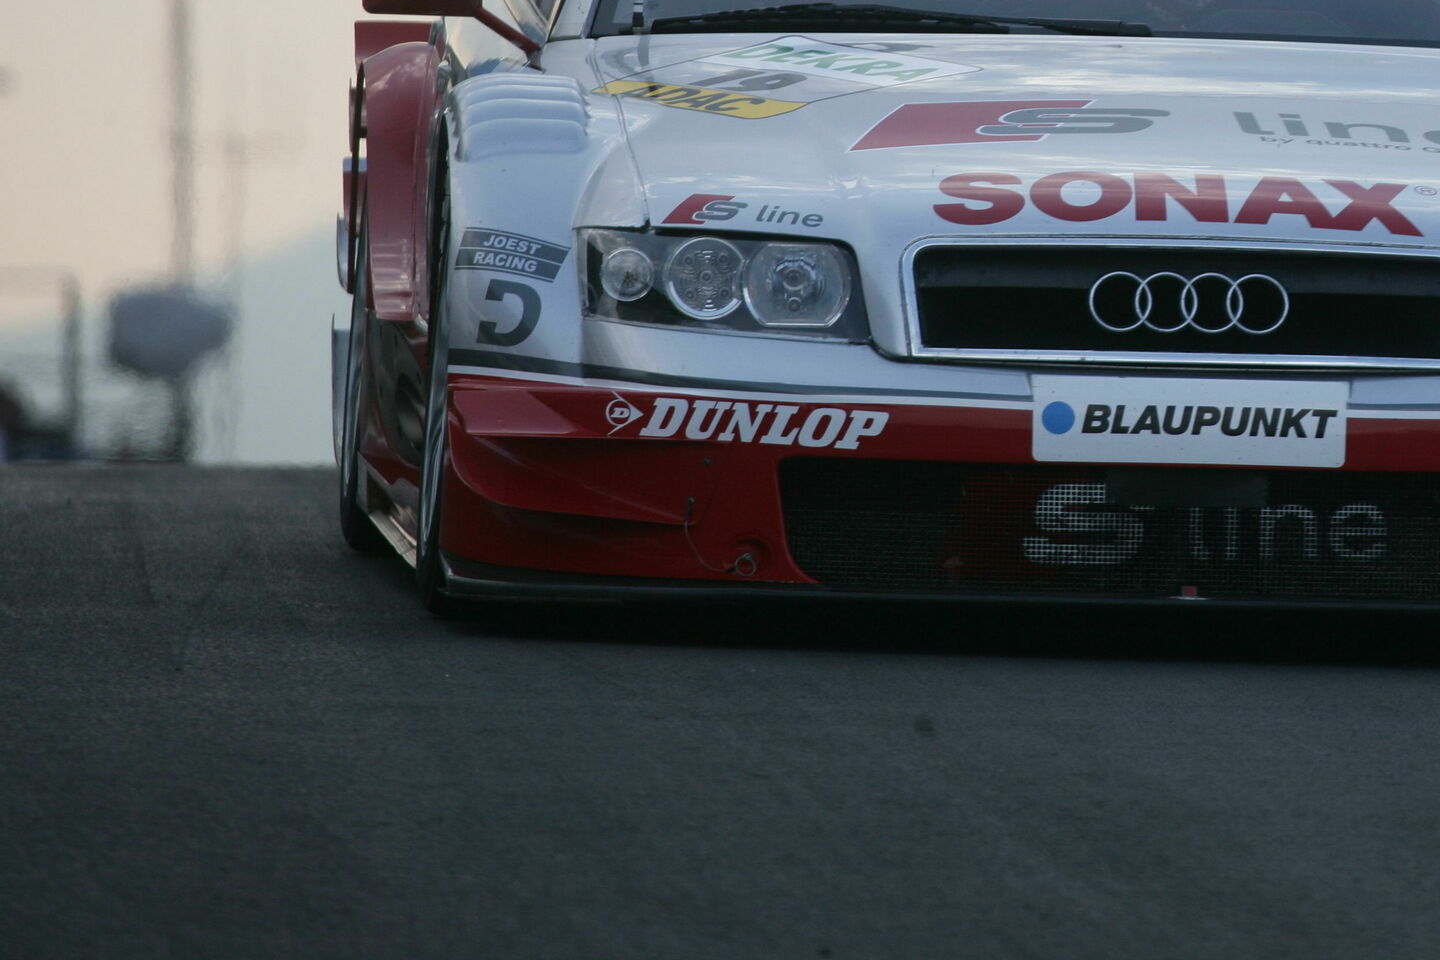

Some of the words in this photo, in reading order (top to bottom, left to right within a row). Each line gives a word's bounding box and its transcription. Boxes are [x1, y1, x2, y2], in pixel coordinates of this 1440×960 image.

[722, 44, 938, 84] DEKRA
[625, 82, 766, 112] ADAC
[1260, 135, 1295, 148] by
[1305, 138, 1412, 152] quattro
[756, 204, 825, 227] line
[932, 170, 1424, 238] SONAX
[483, 234, 541, 255] JOEST
[473, 251, 538, 273] RACING
[639, 397, 890, 451] DUNLOP
[1080, 404, 1338, 439] BLAUPUNKT
